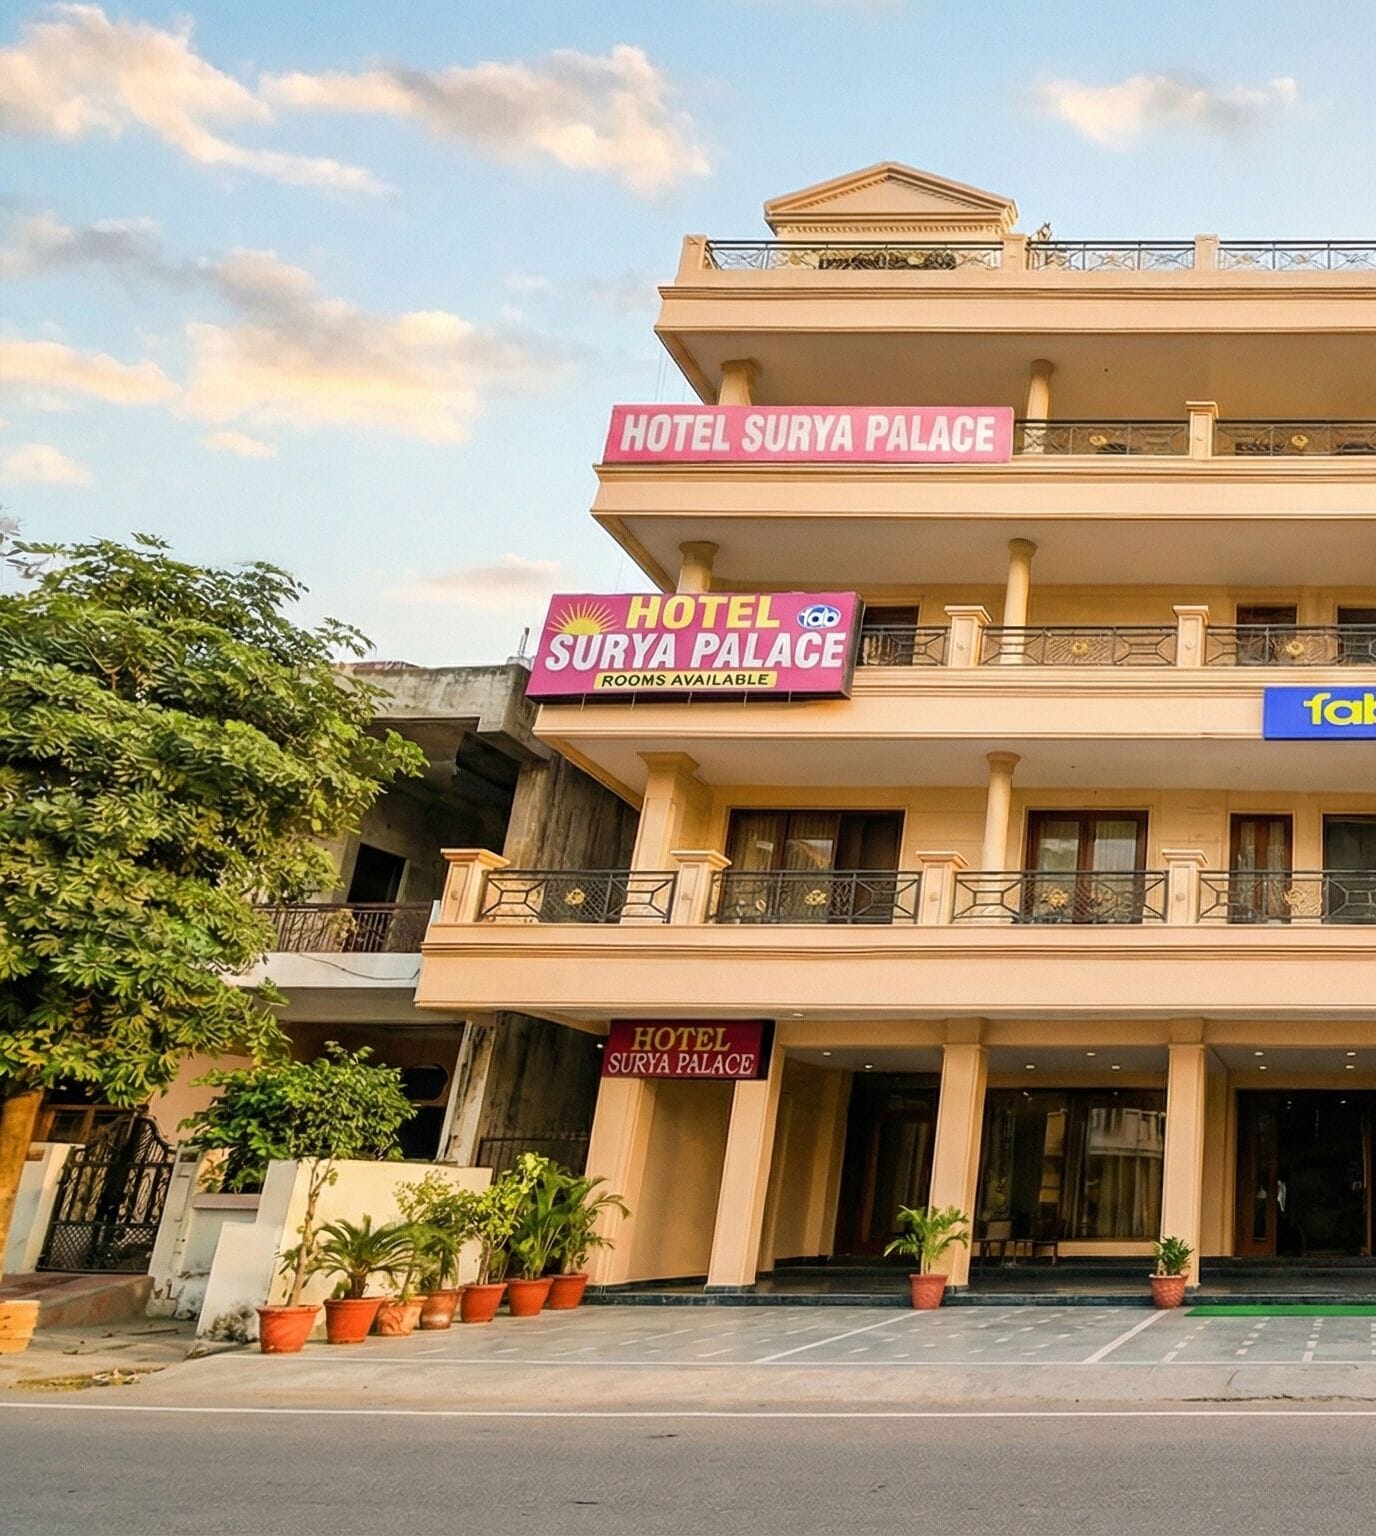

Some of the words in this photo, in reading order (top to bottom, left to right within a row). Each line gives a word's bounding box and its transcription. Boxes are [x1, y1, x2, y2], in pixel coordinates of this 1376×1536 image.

[620, 413, 730, 452] HOTEL
[741, 414, 853, 452] SURYA
[865, 415, 995, 452] PALACE
[625, 595, 780, 629] HOTEL
[800, 607, 839, 627] fab
[544, 632, 676, 671] SURYA
[690, 631, 847, 669] PALACE
[601, 674, 667, 687] ROOMS
[670, 673, 770, 687] AVAILABLE
[631, 1027, 731, 1051] HOTEL
[608, 1052, 670, 1074] SURYA
[677, 1053, 755, 1075] PALACE
